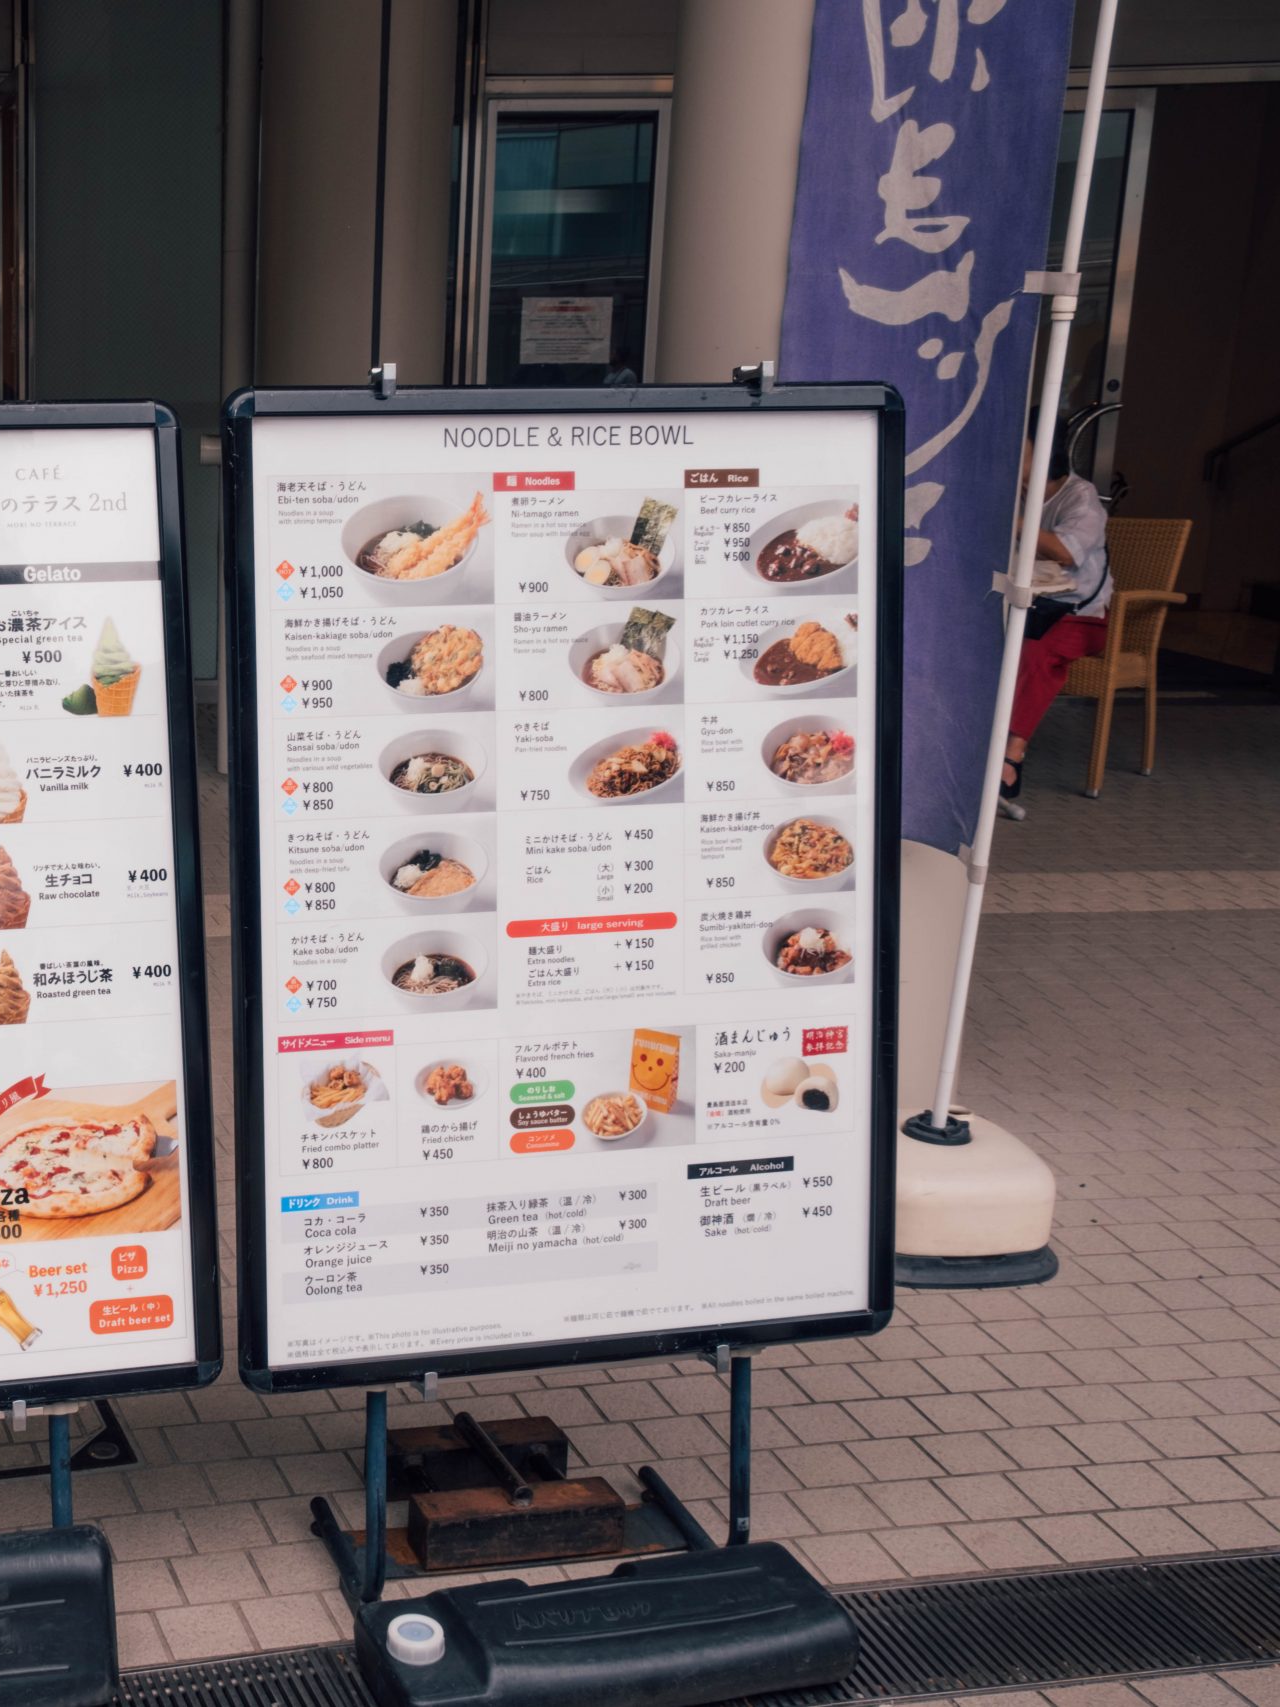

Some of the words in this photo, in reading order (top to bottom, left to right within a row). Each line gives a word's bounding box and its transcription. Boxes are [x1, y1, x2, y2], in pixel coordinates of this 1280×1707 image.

[443, 426, 540, 448] NOODLE
[547, 426, 563, 447] &
[571, 425, 622, 447] RICE
[629, 424, 694, 446] BOWL
[14, 464, 61, 481] CAFÉ
[690, 472, 719, 483] ごはん
[727, 474, 749, 483] Rice
[524, 476, 561, 486] Noodles
[88, 491, 128, 512] 2nd
[277, 495, 310, 505] Ebi-ten
[699, 493, 777, 504] ビーフカレーライス
[511, 509, 553, 520] Ni-tamago
[554, 510, 580, 518] ramen
[700, 506, 718, 515] Beef
[719, 507, 740, 515] curry
[741, 505, 756, 514] rice
[23, 565, 82, 582] Gelato
[700, 605, 769, 616] カツカレーライス
[513, 624, 542, 635] Sho-yu
[543, 625, 569, 633] ramen
[35, 635, 64, 646] green
[66, 634, 84, 643] tea
[701, 715, 718, 725] 牛丼
[513, 721, 550, 732] やきそば
[700, 727, 734, 737] Gyu-don
[514, 734, 554, 743] Yaki-soba
[25, 764, 102, 780] バニラミルク
[39, 782, 69, 792] Vanilla
[70, 781, 89, 791] milk
[525, 846, 544, 855] Mini
[545, 845, 566, 854] kake
[525, 865, 552, 876] ごはん
[45, 873, 93, 888] 生チョコ
[526, 875, 544, 884] Rice
[38, 892, 58, 901] Raw
[58, 889, 100, 900] chocolate
[541, 921, 568, 932] 大盛り
[577, 921, 604, 931] large
[605, 919, 644, 929] serving
[32, 967, 113, 987] 和みほうじ茶
[36, 989, 71, 999] Roasted
[72, 989, 96, 999] green
[281, 1038, 336, 1049] サイドメニュー
[344, 1036, 365, 1045] Side
[365, 1035, 391, 1043] menu
[514, 1040, 578, 1054] フルフルポテト
[515, 1053, 549, 1063] Flavored
[550, 1051, 576, 1061] french
[576, 1051, 595, 1059] fries
[713, 1049, 757, 1059] Saka-manju
[300, 1128, 377, 1143] チキンバスケット
[421, 1135, 443, 1145] Fried
[443, 1134, 475, 1143] chicken
[301, 1144, 323, 1154] Fried
[324, 1142, 352, 1152] combo
[352, 1141, 380, 1152] platter
[699, 1165, 739, 1177] アルコール
[749, 1161, 784, 1172] Alcohol
[288, 1196, 321, 1209] ドリンク
[326, 1195, 354, 1205] Drink
[704, 1197, 728, 1208] Draft
[730, 1196, 751, 1206] beer
[487, 1214, 520, 1225] Green
[522, 1213, 539, 1222] tea
[304, 1227, 332, 1239] Coca
[334, 1225, 357, 1236] cola
[704, 1227, 728, 1238] Sake
[303, 1240, 388, 1256] オレンジジュース
[488, 1242, 514, 1253] Meiji
[516, 1242, 530, 1251] no
[532, 1236, 578, 1252] yamacha
[118, 1251, 136, 1262] ピザ
[305, 1258, 344, 1269] Orange
[346, 1254, 372, 1267] juice
[28, 1265, 63, 1279] Beer
[64, 1262, 88, 1275] set
[117, 1264, 144, 1275] Pizza
[304, 1271, 358, 1286] ウーロン茶
[305, 1284, 343, 1296] Oolong
[345, 1283, 363, 1293] tea
[98, 1317, 126, 1329] Draft
[128, 1316, 151, 1326] beer
[154, 1313, 171, 1323] set
